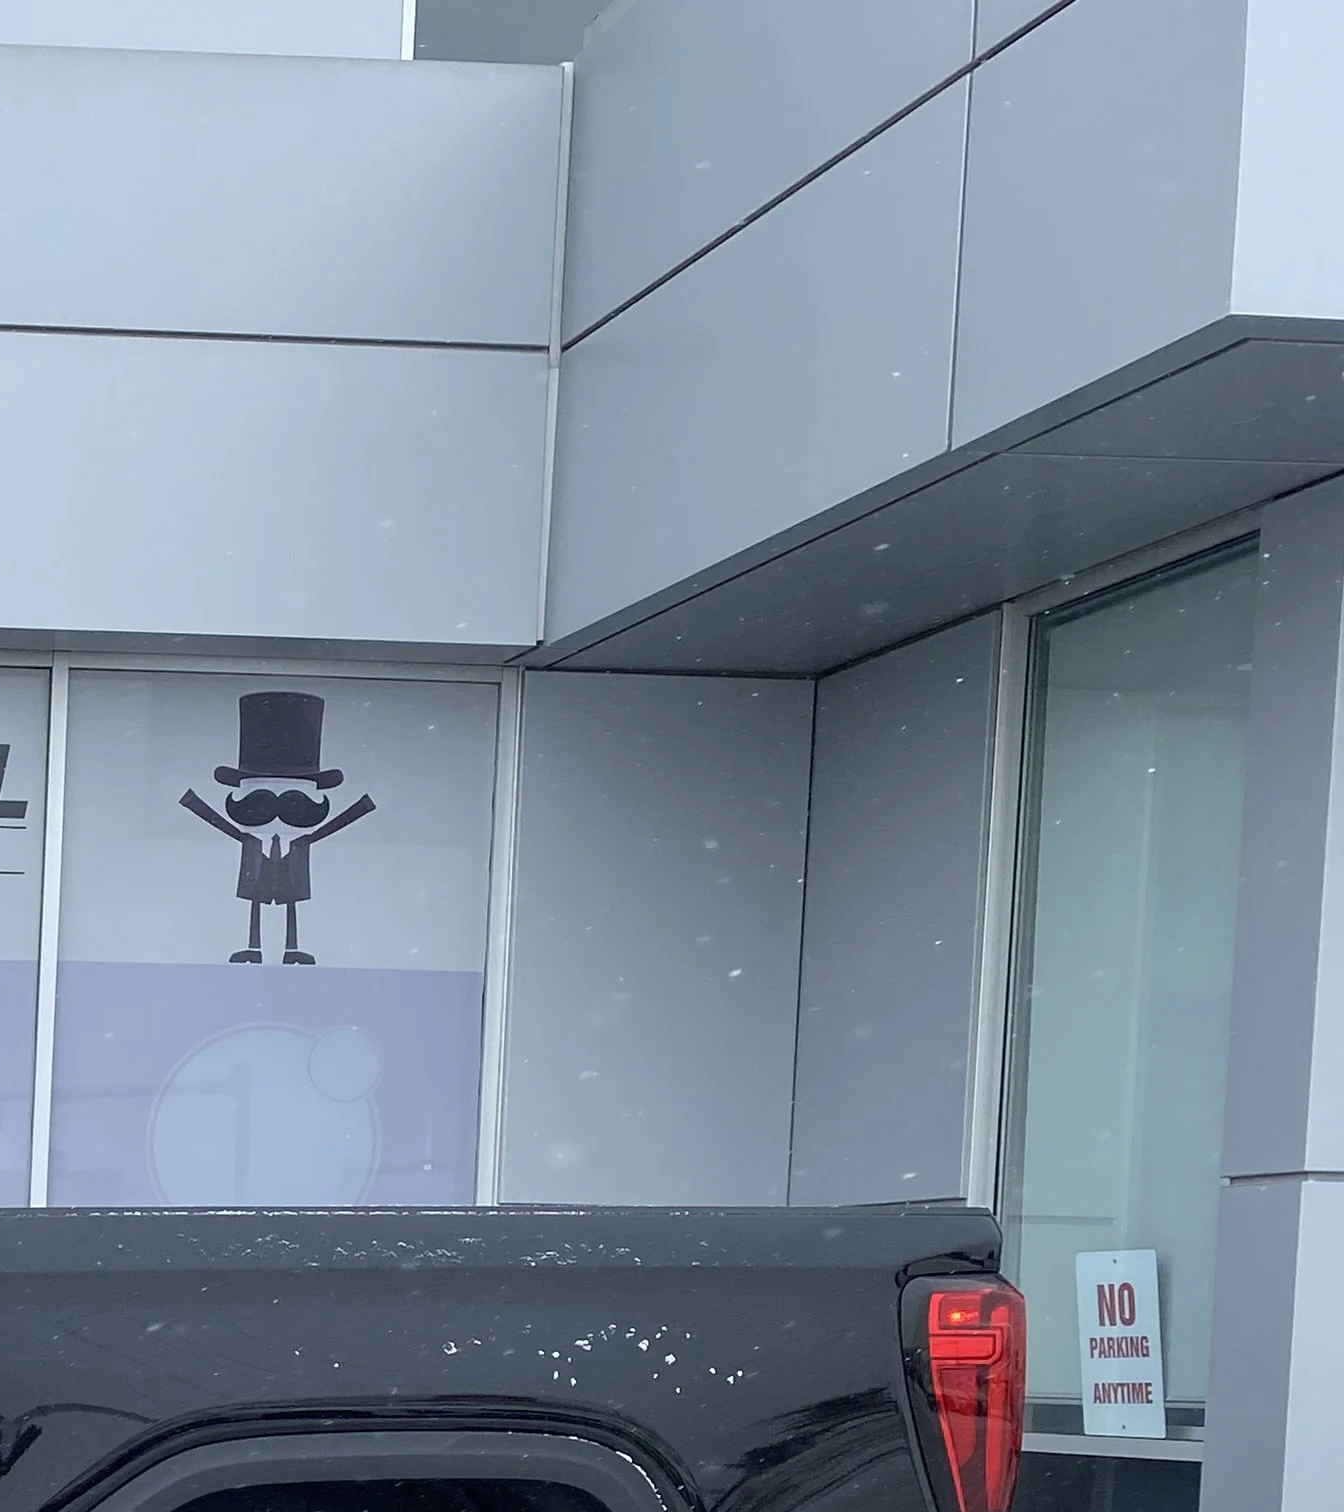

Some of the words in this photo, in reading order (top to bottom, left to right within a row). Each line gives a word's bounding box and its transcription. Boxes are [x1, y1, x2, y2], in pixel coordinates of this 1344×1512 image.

[1096, 1282, 1137, 1327] NO
[1089, 1335, 1151, 1359] PARKING
[1092, 1382, 1154, 1405] ANYTIME
